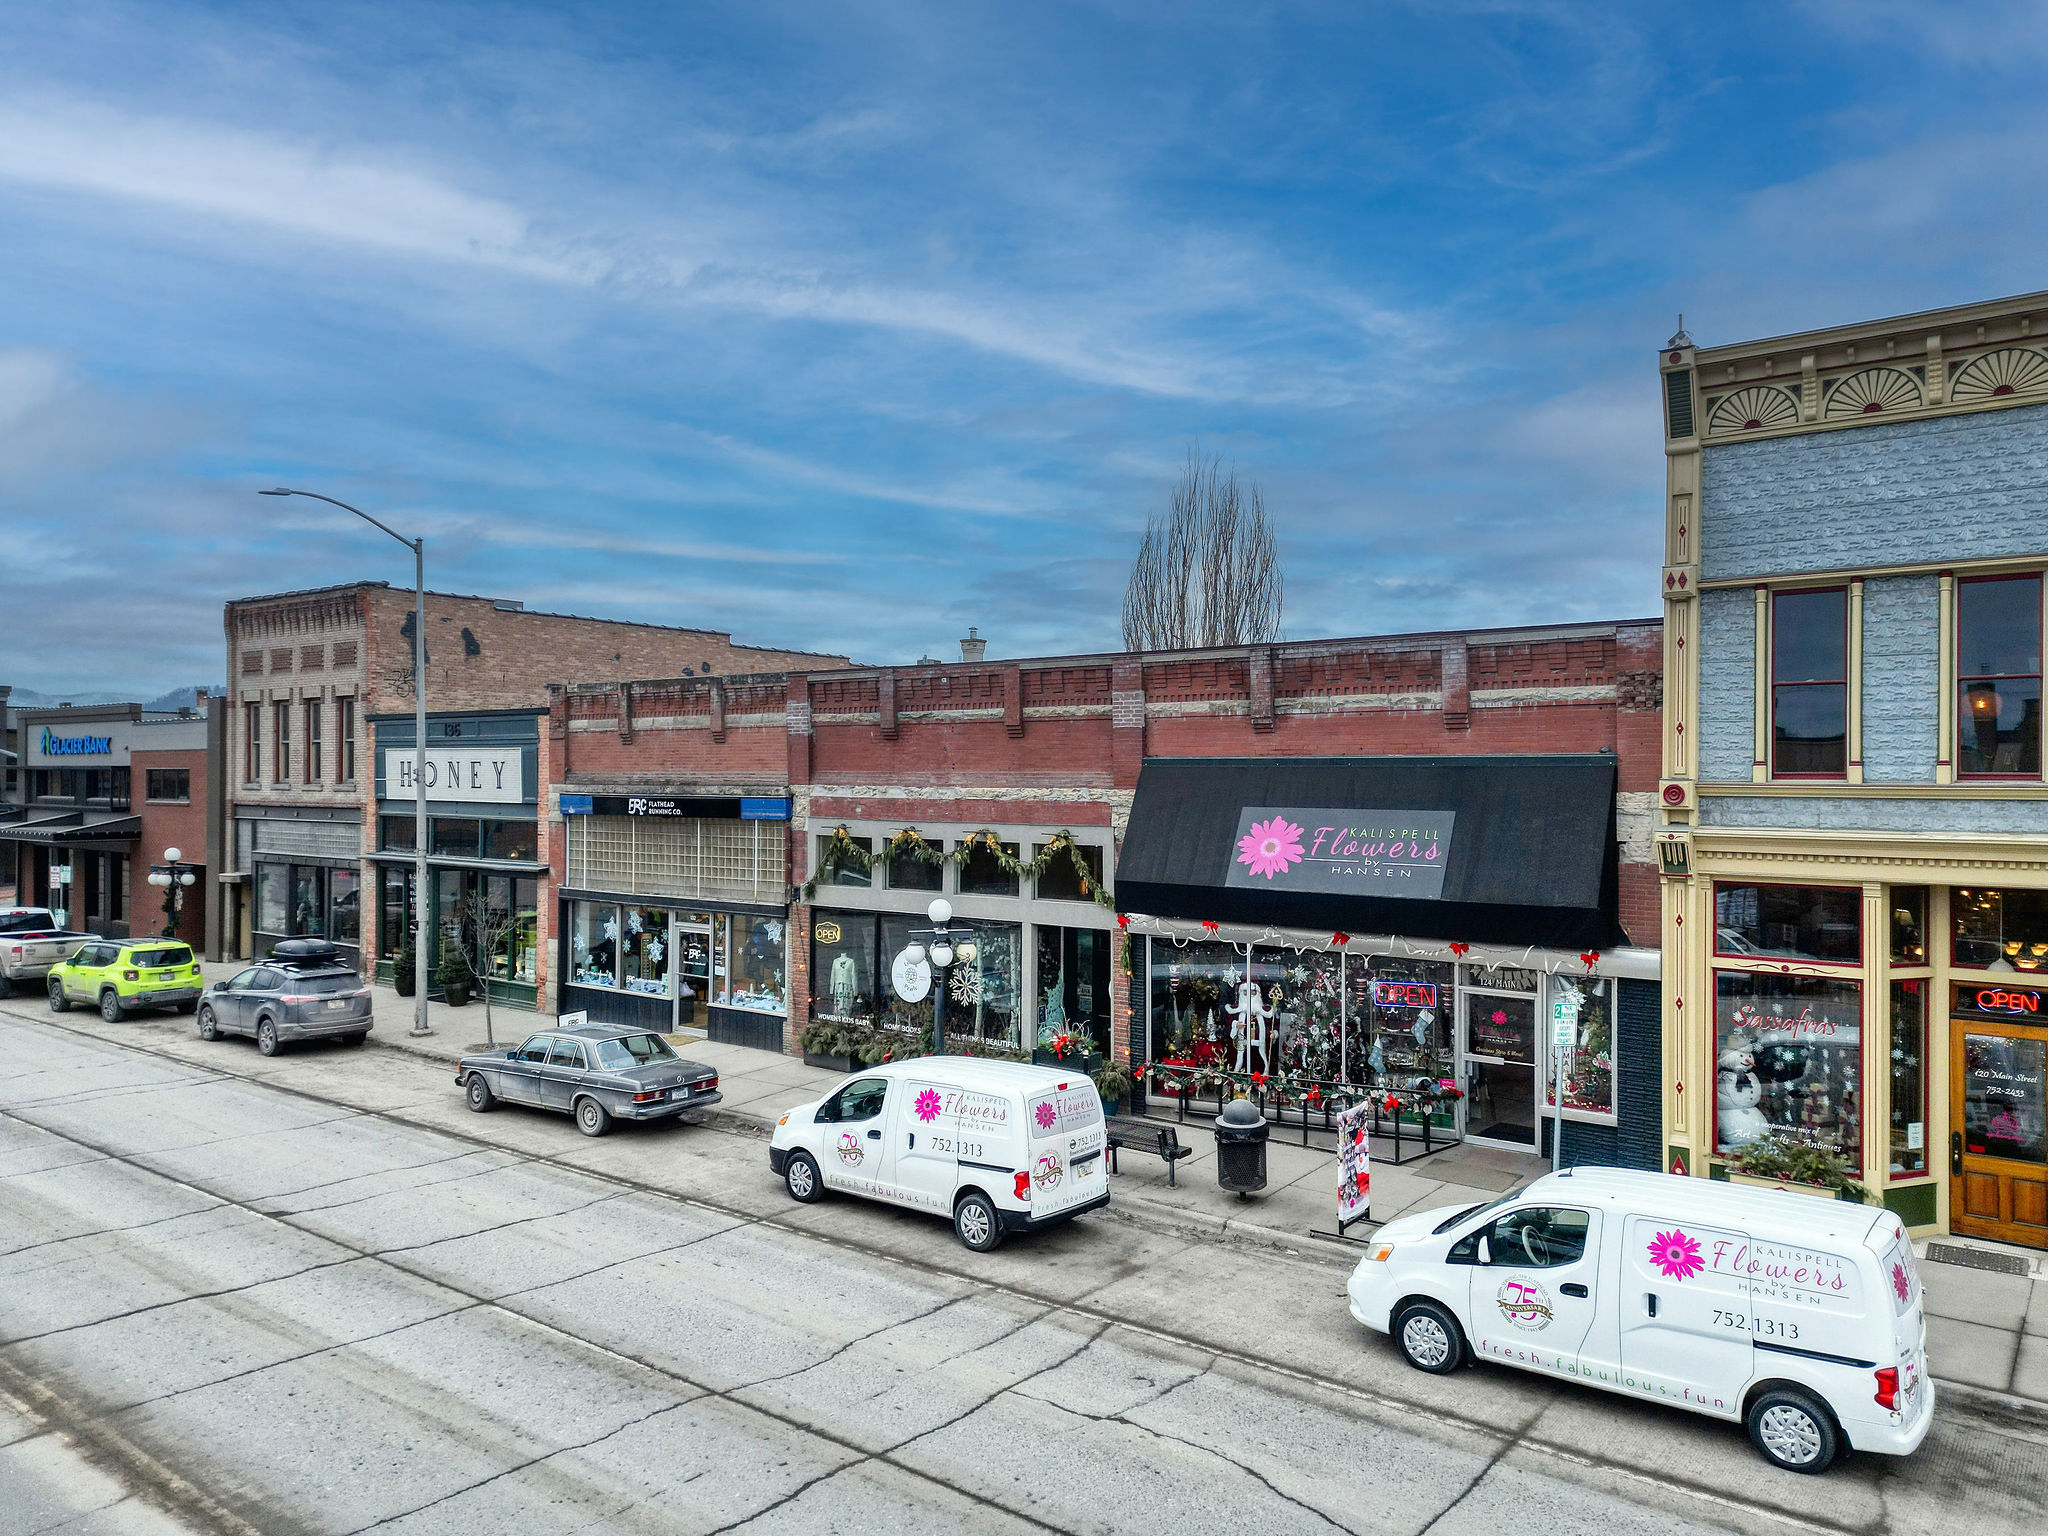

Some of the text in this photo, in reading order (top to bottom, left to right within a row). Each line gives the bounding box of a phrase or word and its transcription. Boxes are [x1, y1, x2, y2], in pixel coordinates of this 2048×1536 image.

[50, 735, 111, 754] GLACIER BANK
[400, 761, 505, 789] HONEY
[628, 798, 647, 816] FRC
[1350, 827, 1439, 840] KALISPELL
[1311, 827, 1442, 860] Flowers
[1364, 857, 1380, 868] by
[1331, 866, 1412, 878] HANSEN
[816, 929, 839, 940] OPEN
[1480, 977, 1516, 989] 124 MAIN
[1376, 984, 1435, 1006] OPEN
[1977, 990, 2038, 1012] OPEN
[1555, 1005, 1561, 1017] 2
[855, 1017, 870, 1026] BABY
[1731, 1005, 1839, 1040] Sassafras
[985, 1037, 1020, 1049] BEAUTIFUL
[1975, 1068, 2038, 1084] 120 Main Street
[1985, 1085, 2025, 1097] 752-2433
[944, 1093, 1007, 1120] Flowers
[966, 1095, 1007, 1106] KALISPELL
[1056, 1098, 1094, 1115] Flowers
[954, 1121, 994, 1132] HANSEN
[1734, 1129, 1751, 1138] Art
[1798, 1127, 1811, 1135] mix
[1811, 1126, 1821, 1137] of
[842, 1133, 858, 1161] 70
[931, 1137, 982, 1157] 752.1313
[1039, 1155, 1056, 1184] 70
[1713, 1240, 1847, 1290] Flowers
[1756, 1246, 1842, 1268] KALISPELL
[1771, 1279, 1787, 1289] by
[1507, 1282, 1537, 1321] 75
[1739, 1283, 1821, 1304] HANSEN
[1713, 1309, 1799, 1339] 752.1313
